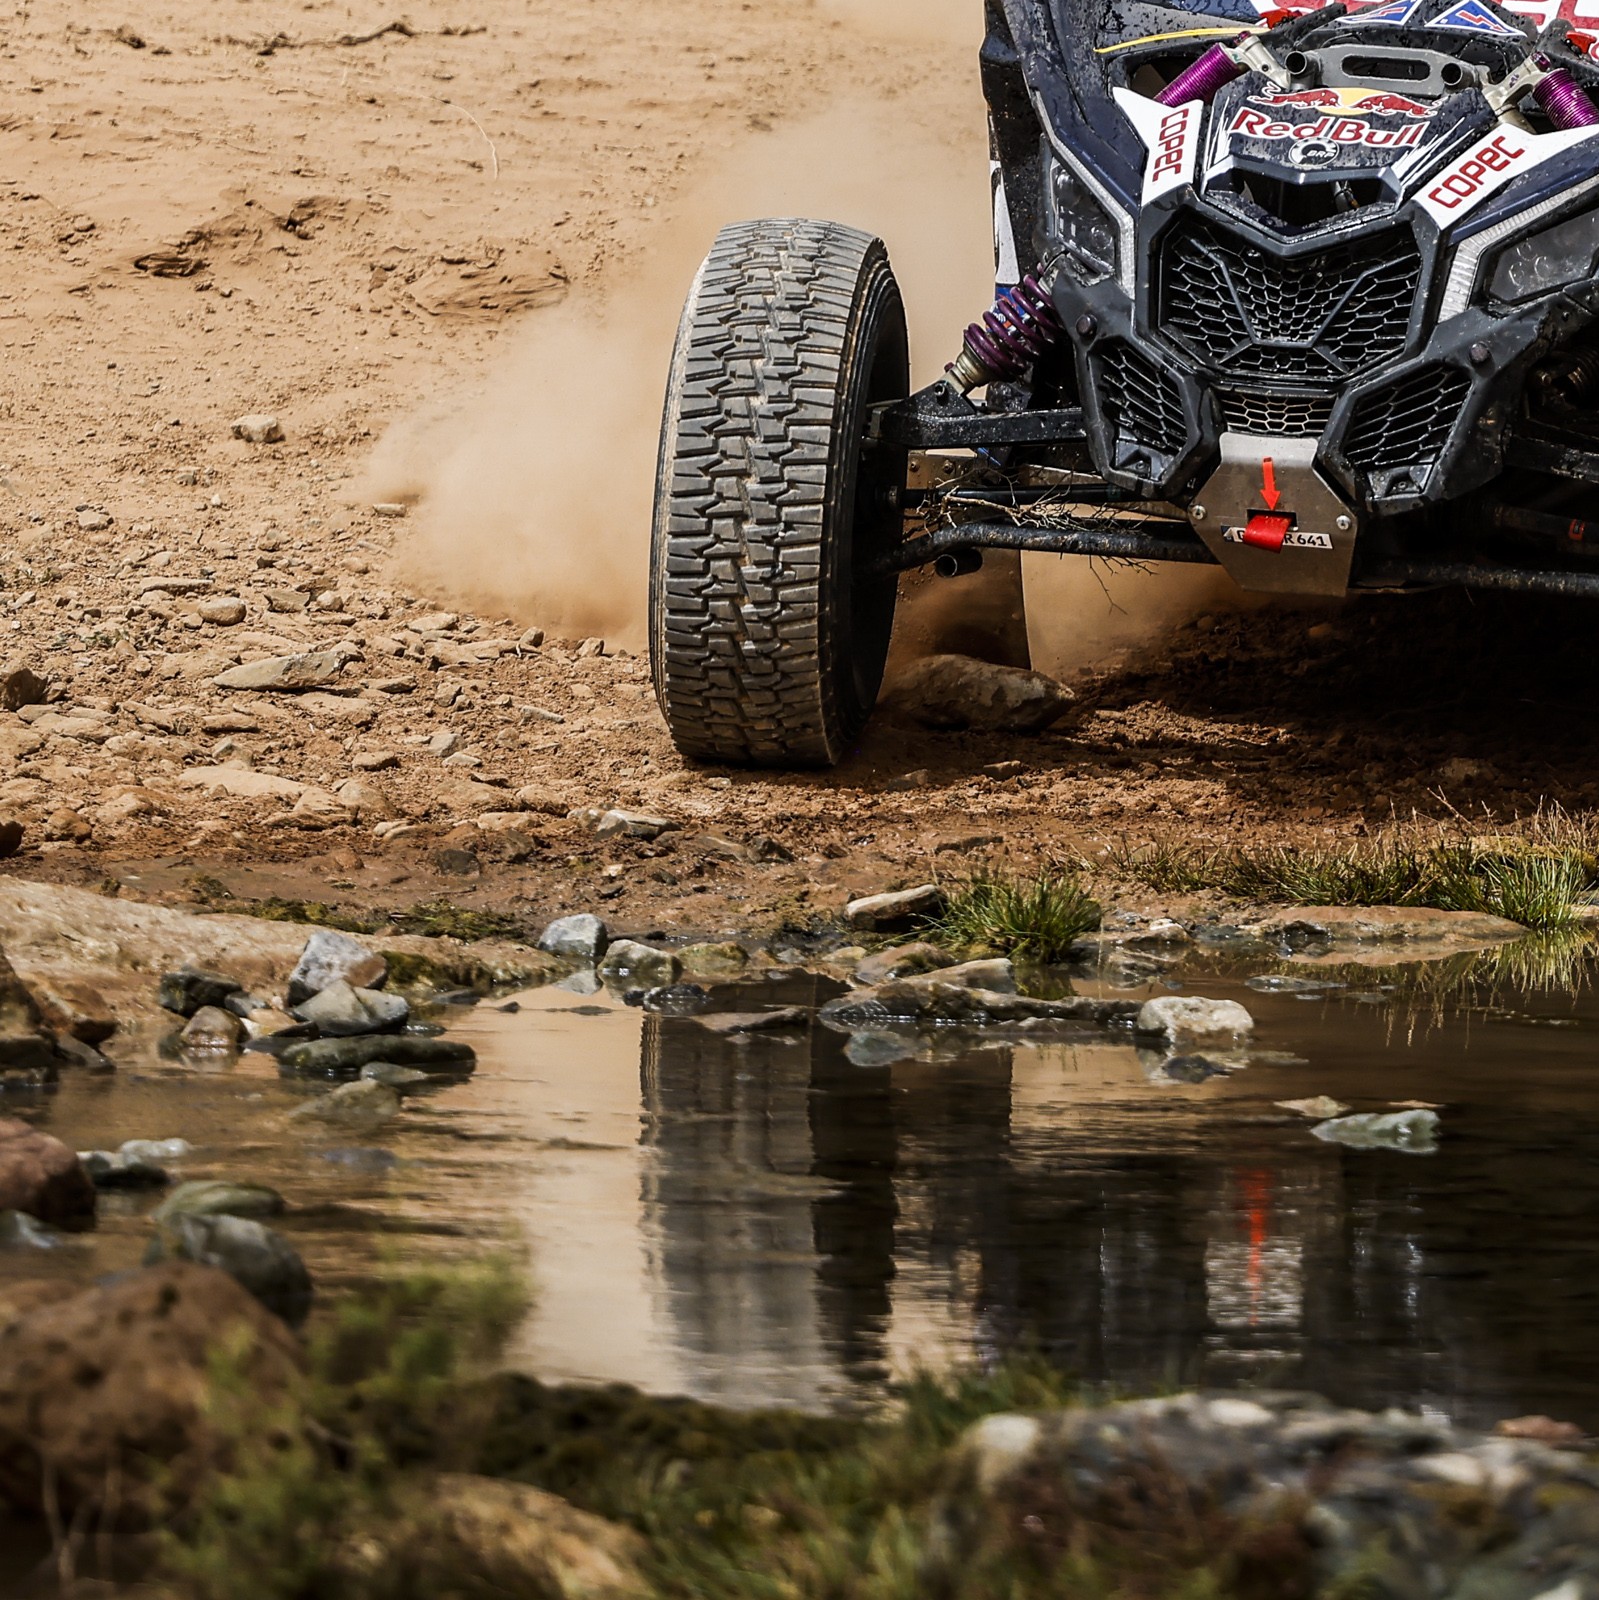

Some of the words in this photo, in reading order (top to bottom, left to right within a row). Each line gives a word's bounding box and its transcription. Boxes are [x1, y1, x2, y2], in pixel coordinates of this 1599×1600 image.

[1229, 106, 1336, 139] Red
[1332, 118, 1430, 148] Bull
[1307, 149, 1336, 159] BRP
[1297, 534, 1327, 547] 641
